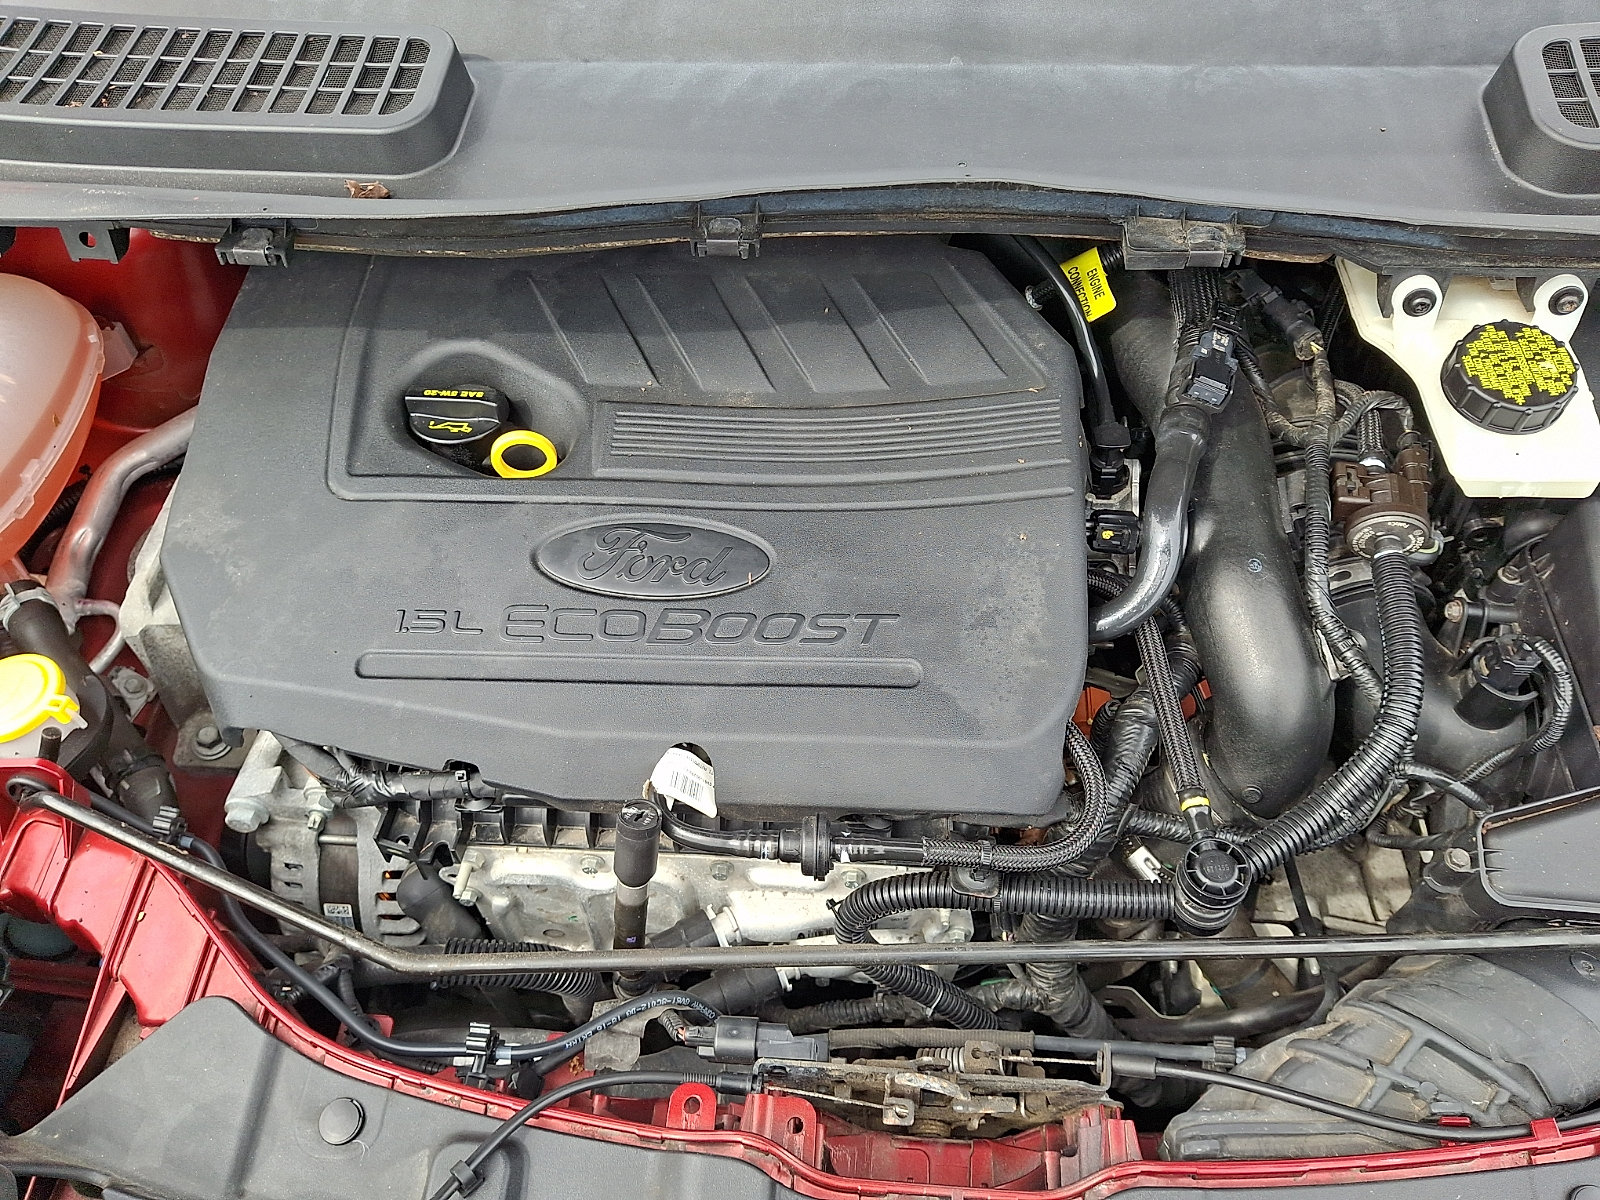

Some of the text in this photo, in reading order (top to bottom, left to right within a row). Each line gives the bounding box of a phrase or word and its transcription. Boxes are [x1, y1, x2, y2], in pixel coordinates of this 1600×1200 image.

[1086, 267, 1106, 301] ENGINE
[1067, 266, 1093, 318] CONNECTION
[1522, 328, 1535, 341] ONLY
[1474, 340, 1486, 350] DOT
[1518, 339, 1534, 358] SEALED
[1528, 343, 1541, 353] DOT
[1487, 354, 1501, 365] QUE
[1542, 335, 1572, 385] CLEAN FILLER CAP
[423, 389, 458, 397] 5W-20
[1544, 379, 1559, 396] FROM
[1554, 382, 1567, 393] USE
[577, 527, 732, 587] Ford
